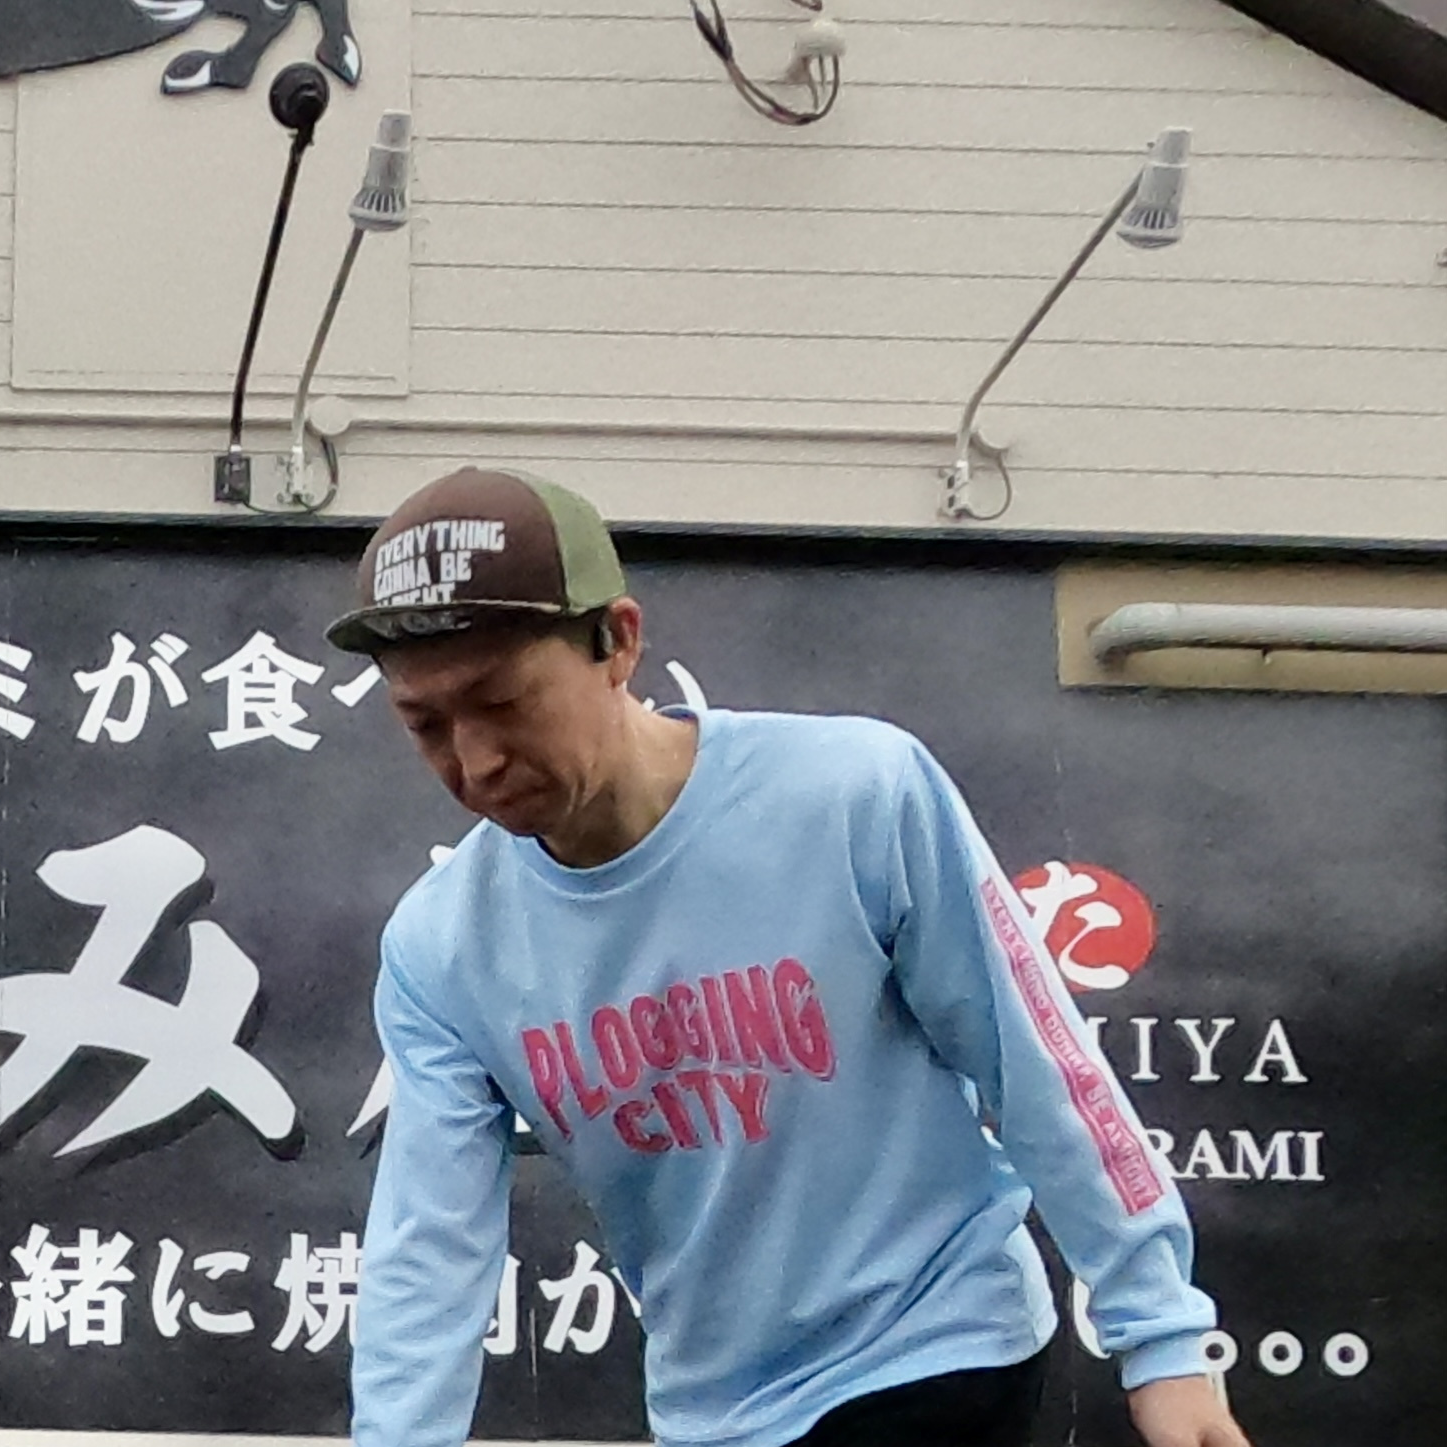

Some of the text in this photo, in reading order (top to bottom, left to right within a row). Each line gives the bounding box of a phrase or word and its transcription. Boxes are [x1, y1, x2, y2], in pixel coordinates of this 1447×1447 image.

[374, 550, 472, 602] GONNA BE
[375, 519, 505, 574] EVERYTHING
[1020, 860, 1130, 990] た
[522, 957, 835, 1144] PLOGGING
[1087, 1015, 1309, 1083] IYA
[613, 1071, 770, 1154] CITY
